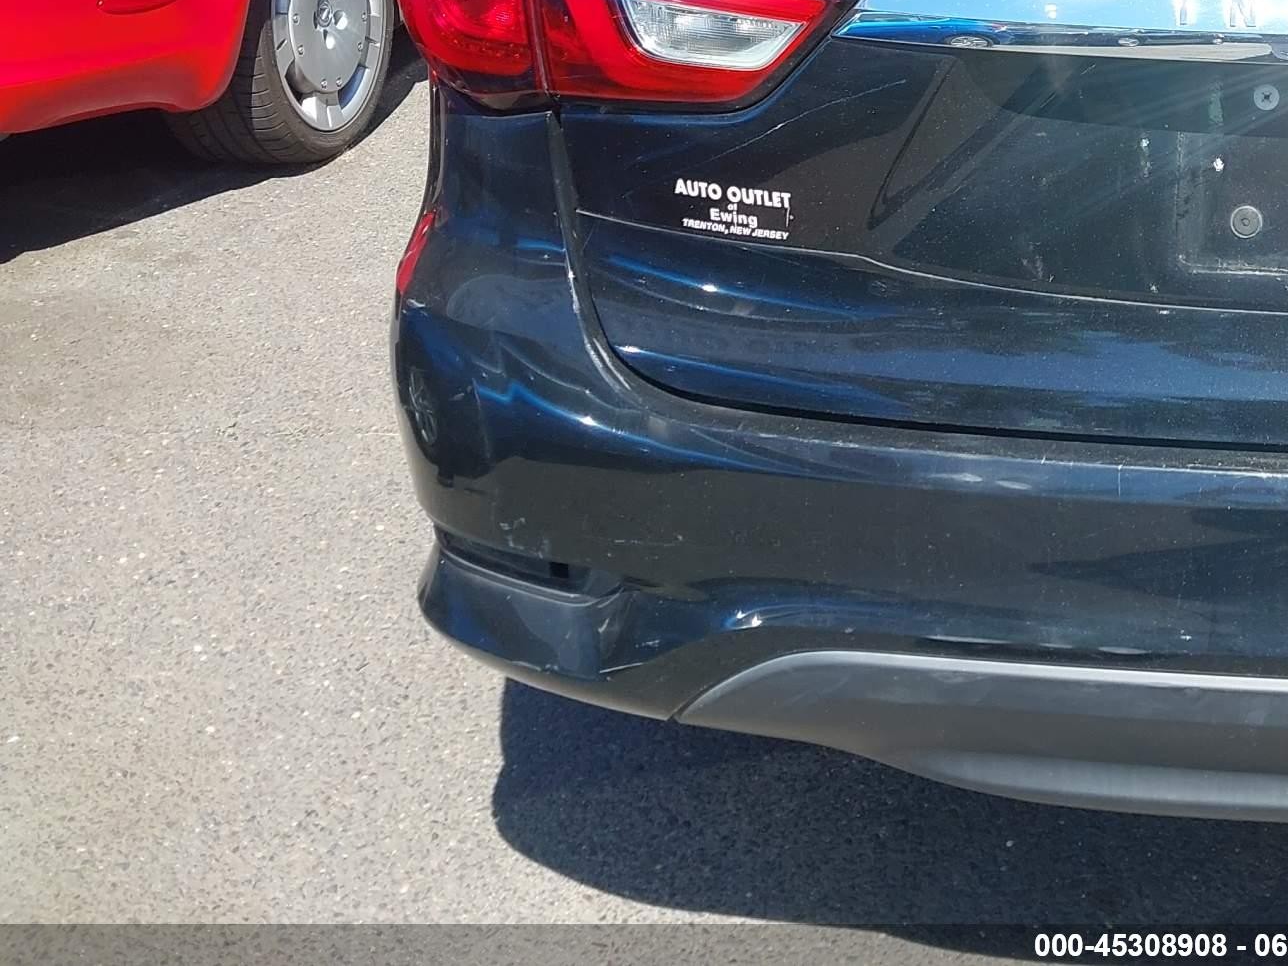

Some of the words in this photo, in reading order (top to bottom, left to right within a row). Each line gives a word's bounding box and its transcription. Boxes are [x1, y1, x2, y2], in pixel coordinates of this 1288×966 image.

[674, 178, 722, 200] AUTO
[726, 186, 792, 208] OUTLET
[727, 202, 738, 211] of
[681, 218, 729, 235] TRENTON,
[729, 225, 752, 236] NEW
[752, 228, 790, 241] JERSEY
[709, 208, 758, 229] Ewing
